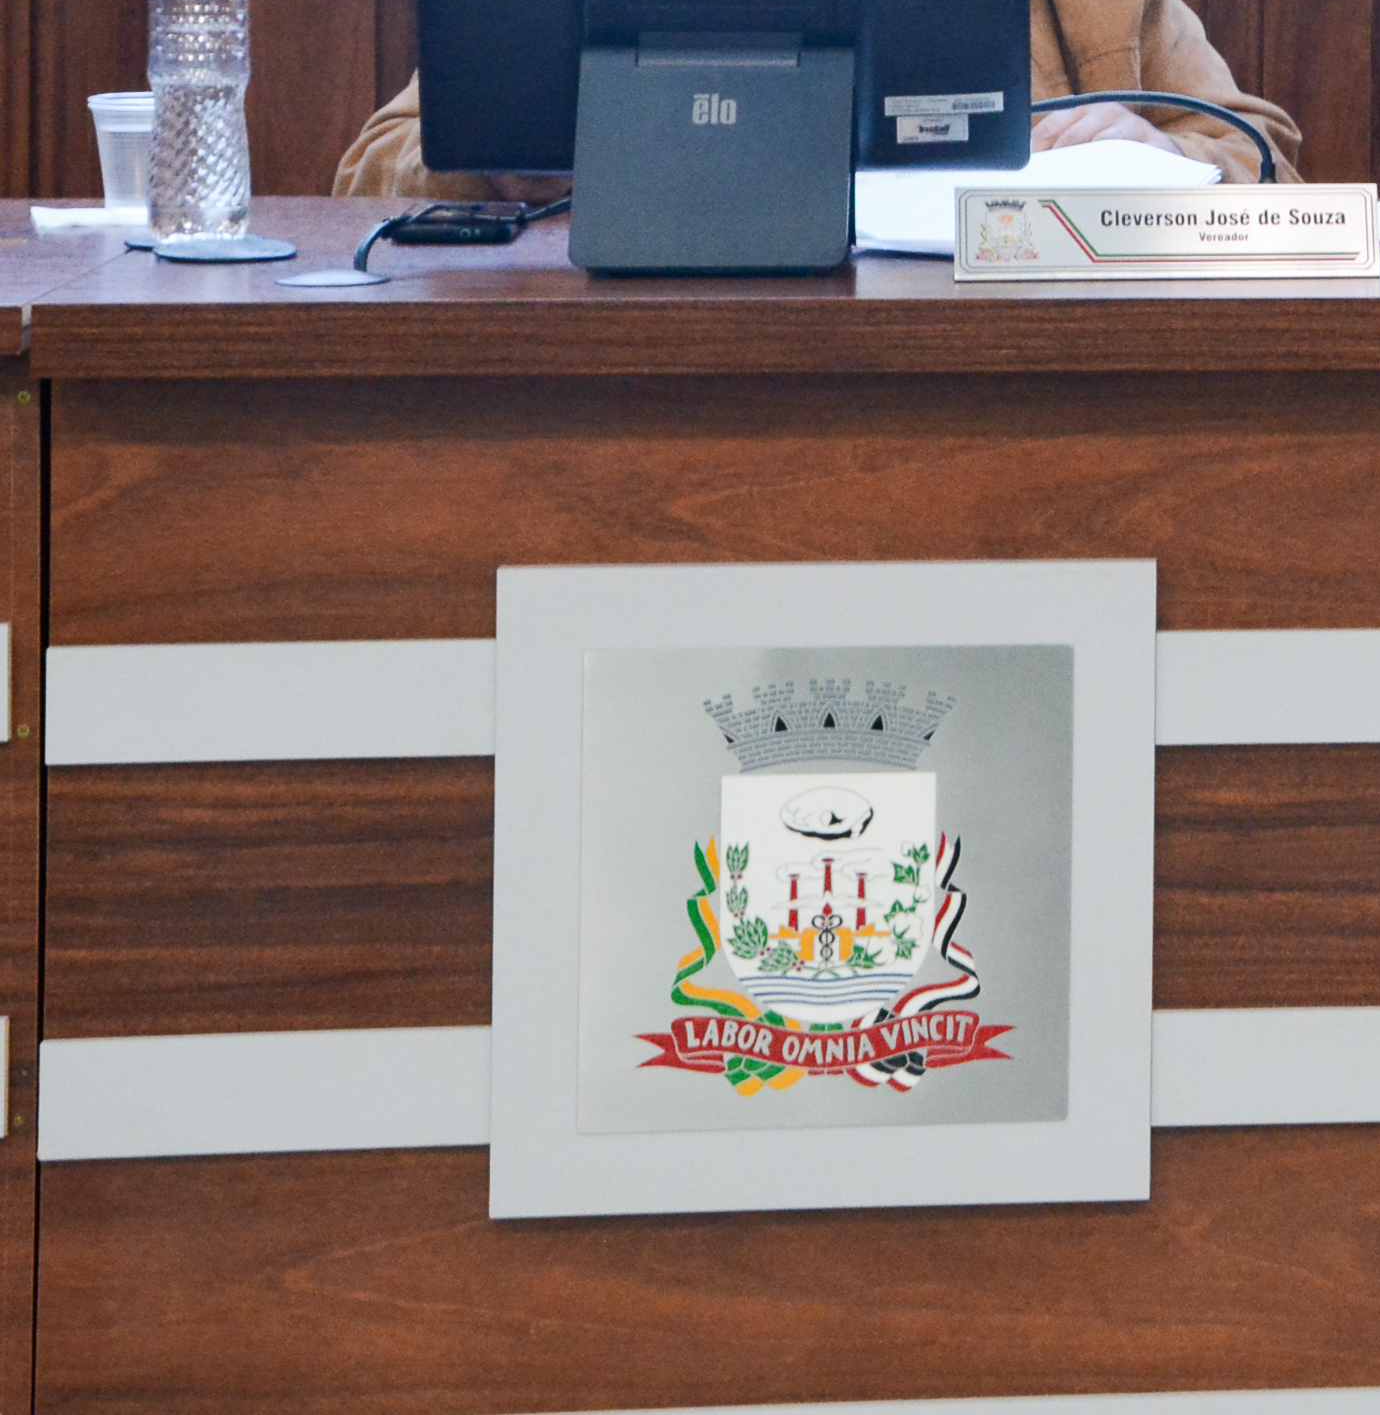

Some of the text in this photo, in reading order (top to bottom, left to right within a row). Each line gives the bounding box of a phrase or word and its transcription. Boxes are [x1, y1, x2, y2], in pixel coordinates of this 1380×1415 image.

[1100, 208, 1347, 227] Cleverson José de Souza
[1199, 231, 1249, 242] Vereador
[685, 1014, 974, 1064] LABOR OMNIA VINCIT
